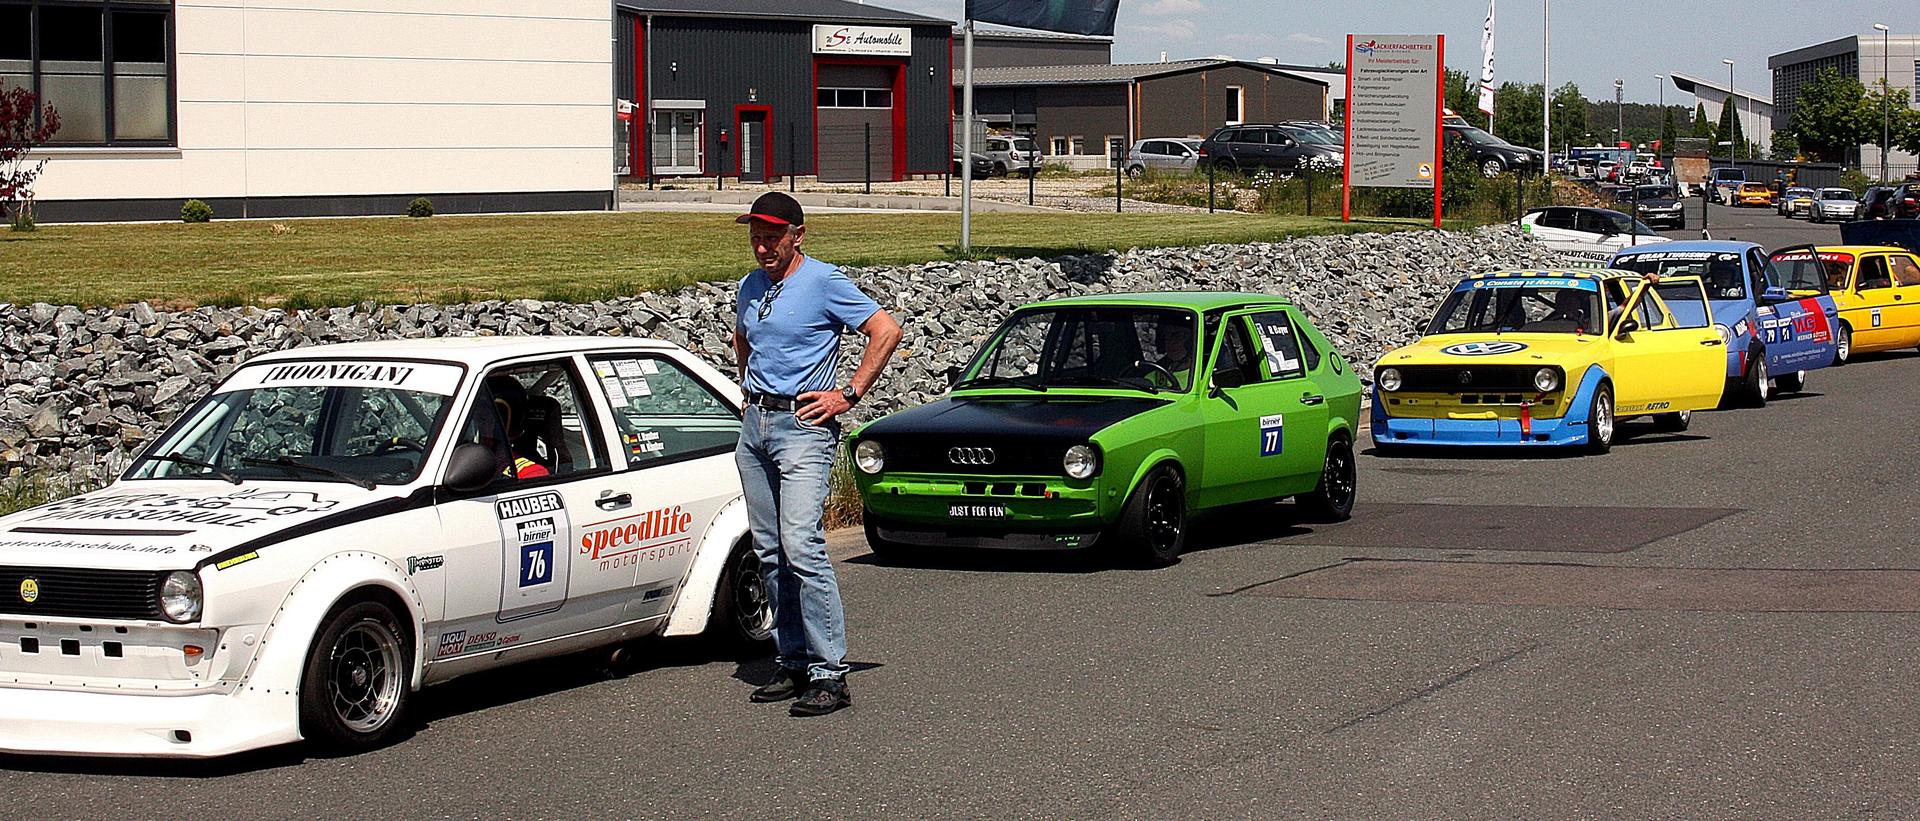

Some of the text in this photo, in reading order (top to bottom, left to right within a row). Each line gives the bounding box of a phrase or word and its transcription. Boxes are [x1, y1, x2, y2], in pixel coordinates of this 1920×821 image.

[854, 32, 902, 45] Automobile
[1645, 401, 1670, 410] RETRO
[1265, 431, 1279, 452] 77
[500, 494, 560, 518] HAUBER
[949, 506, 969, 516] JUST
[971, 506, 987, 516] FOR
[523, 530, 551, 542] birner
[580, 505, 692, 560] speedlife
[599, 541, 692, 572] motorsport
[527, 549, 546, 580] 76
[441, 631, 466, 645] LIQUI
[467, 631, 497, 645] DENSO
[438, 643, 464, 656] MOLY
